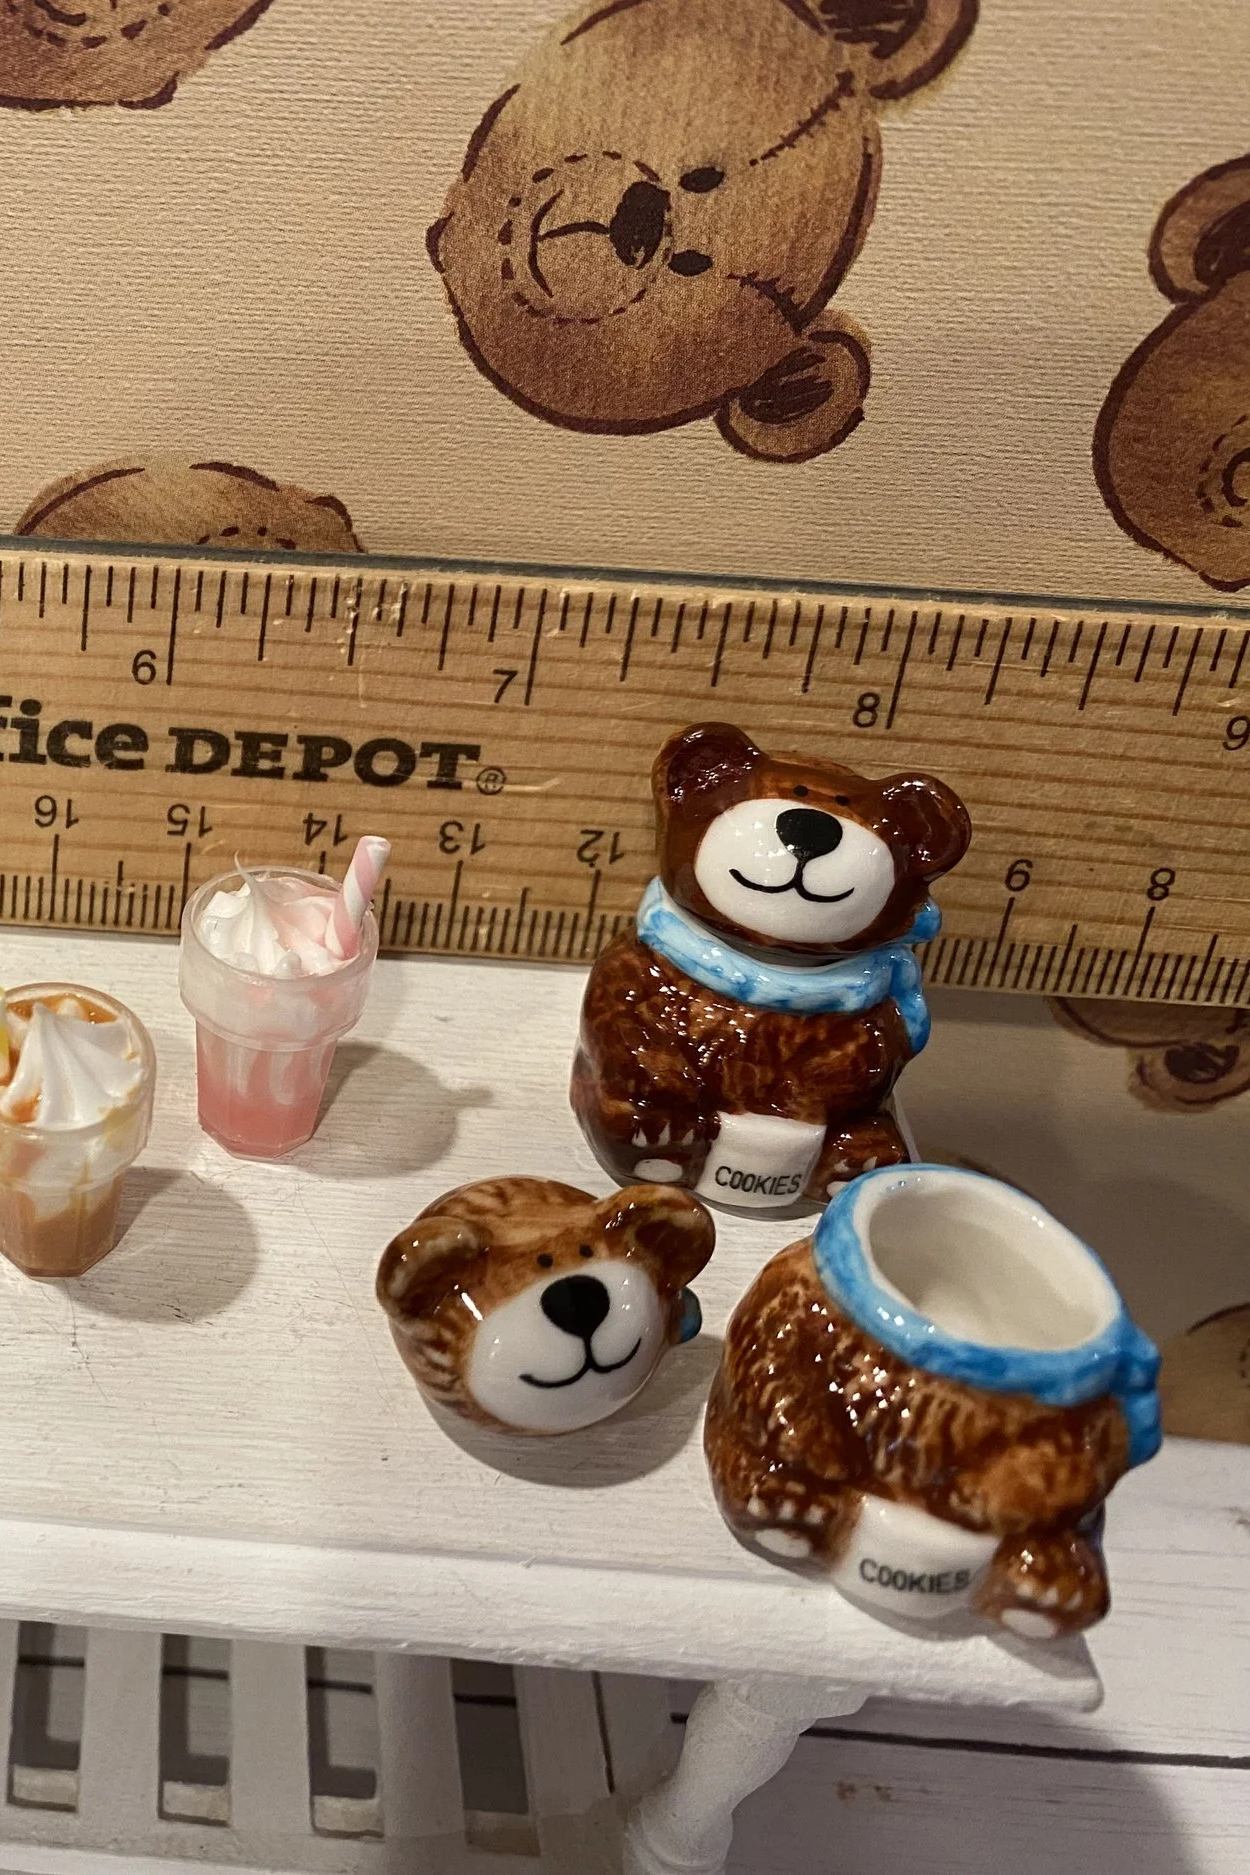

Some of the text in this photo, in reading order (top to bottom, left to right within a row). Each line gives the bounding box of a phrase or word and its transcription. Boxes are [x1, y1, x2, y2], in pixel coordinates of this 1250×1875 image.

[132, 650, 157, 685] 6
[492, 668, 518, 704] 7
[852, 692, 881, 728] 8
[1222, 715, 1250, 751] 9
[34, 794, 80, 829] 16
[166, 803, 212, 838] 15
[302, 811, 349, 847] 14
[438, 820, 486, 855] 13
[576, 828, 628, 865] 12
[1146, 867, 1176, 902] 8
[715, 1165, 802, 1196] COOKIES
[859, 1558, 971, 1595] COOKIES
